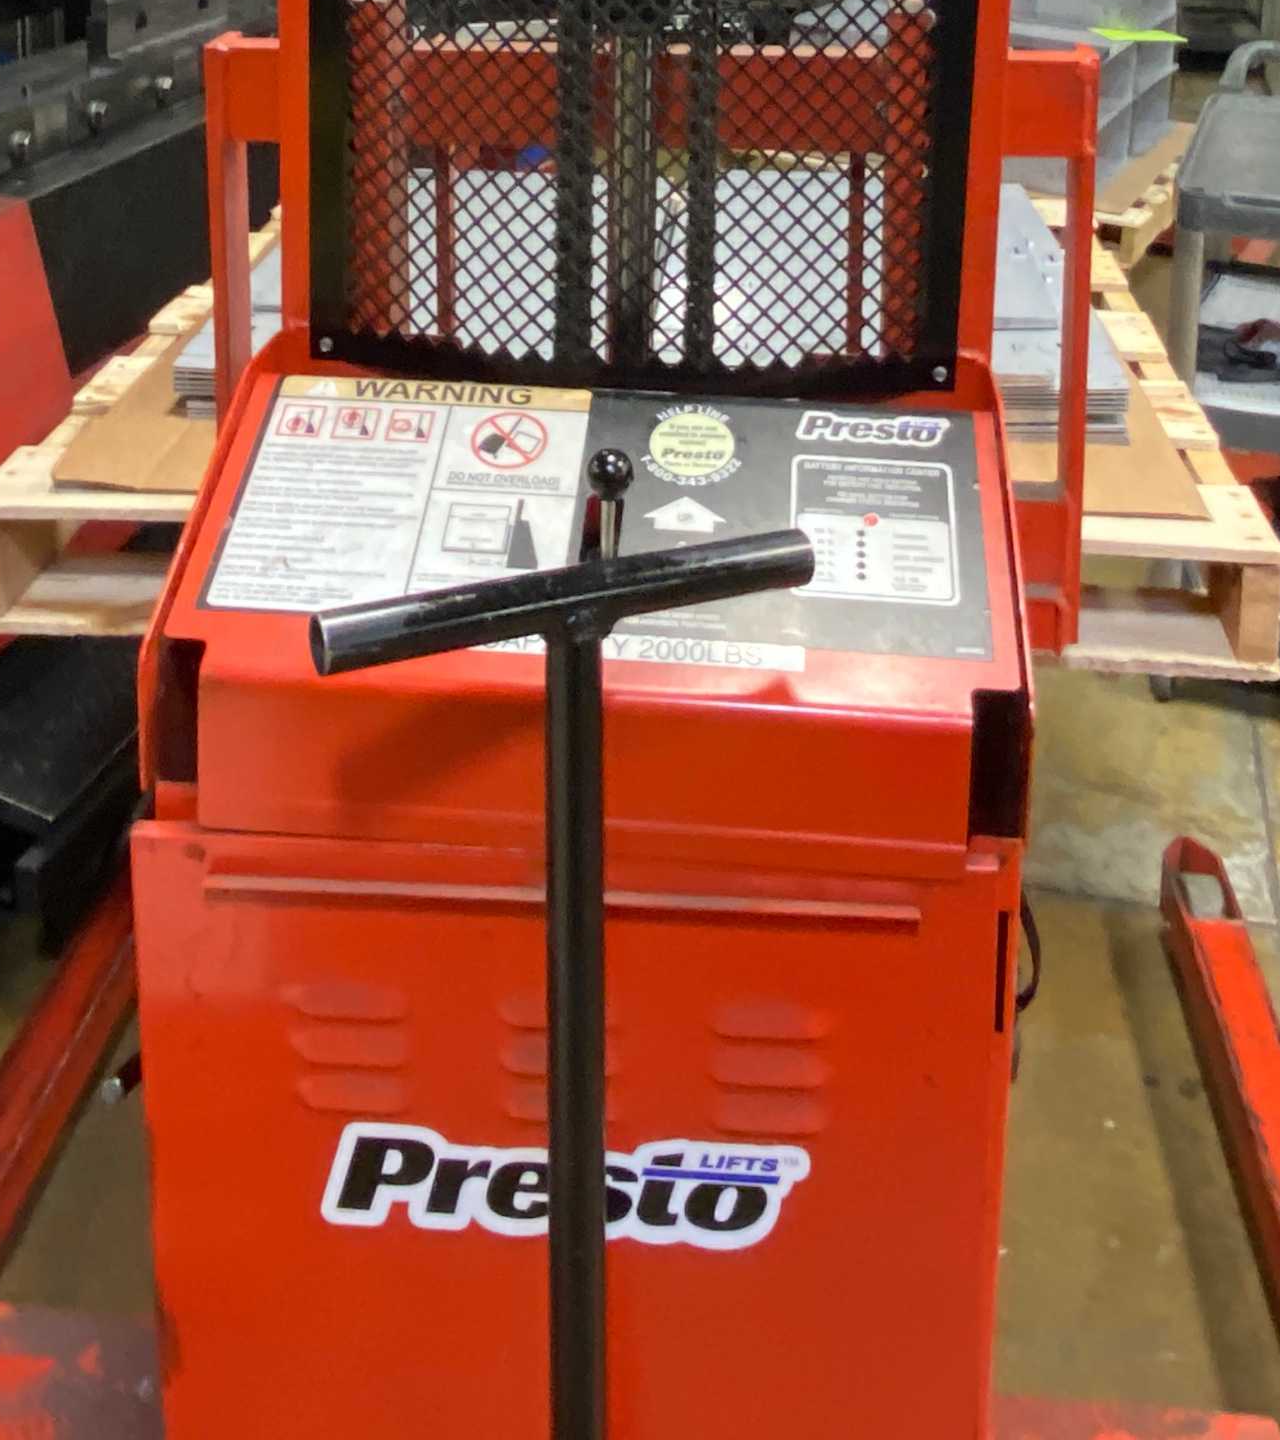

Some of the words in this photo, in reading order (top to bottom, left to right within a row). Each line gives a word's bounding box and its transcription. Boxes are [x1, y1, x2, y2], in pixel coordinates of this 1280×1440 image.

[355, 379, 532, 406] WARNING
[800, 413, 943, 443] Presto
[638, 639, 763, 666] 2000LBS
[336, 1136, 770, 1232] Presto
[698, 1152, 780, 1173] LIFTS
